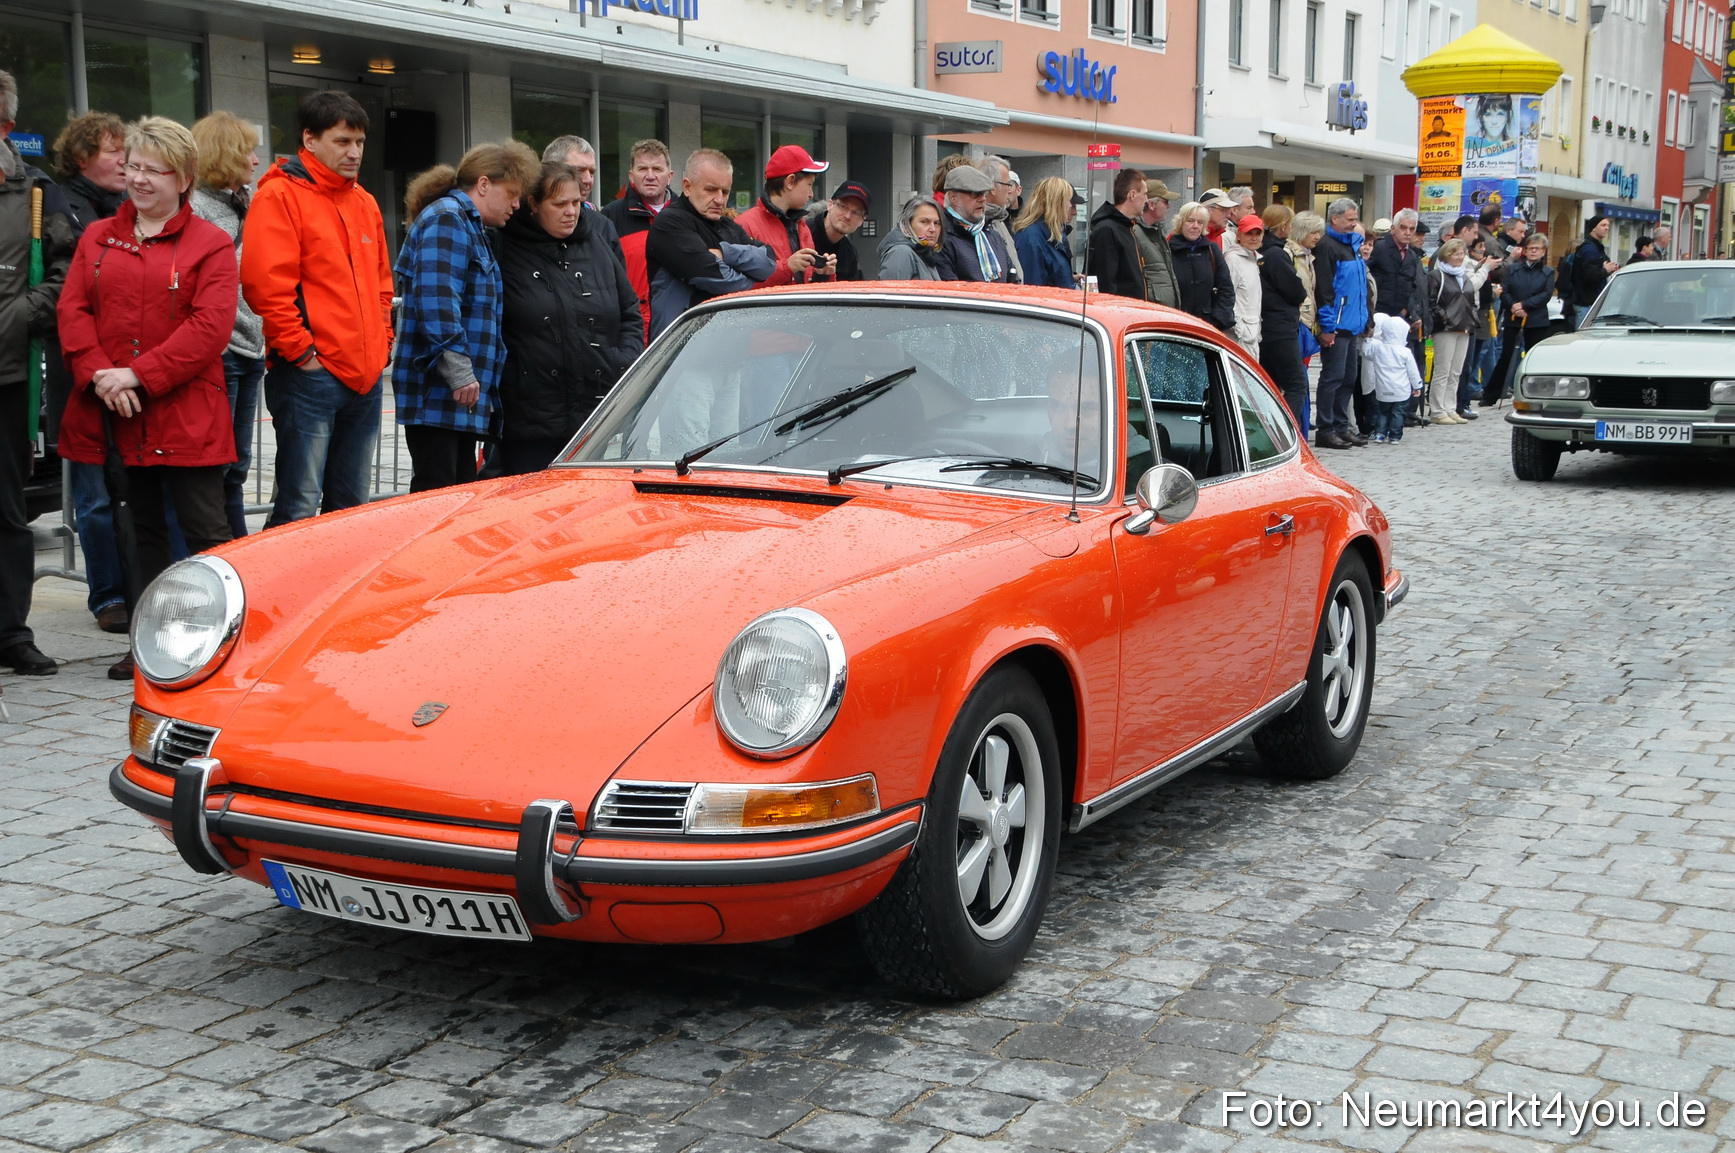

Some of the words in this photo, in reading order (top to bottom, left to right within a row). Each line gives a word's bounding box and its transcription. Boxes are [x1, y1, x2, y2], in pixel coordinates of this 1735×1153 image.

[936, 46, 995, 68] sutor.
[1040, 47, 1117, 104] sutor.
[1336, 80, 1368, 130] fries
[1424, 107, 1464, 115] Flohmarkt
[1424, 141, 1456, 150] Samstag
[1486, 145, 1505, 157] OPEN
[1424, 150, 1454, 159] 01.06.
[1465, 160, 1487, 169] 25.6.
[1316, 183, 1348, 193] FRIES
[1605, 424, 1626, 439] NM
[1635, 425, 1655, 440] BB
[281, 887, 292, 899] D
[287, 871, 342, 912] NM
